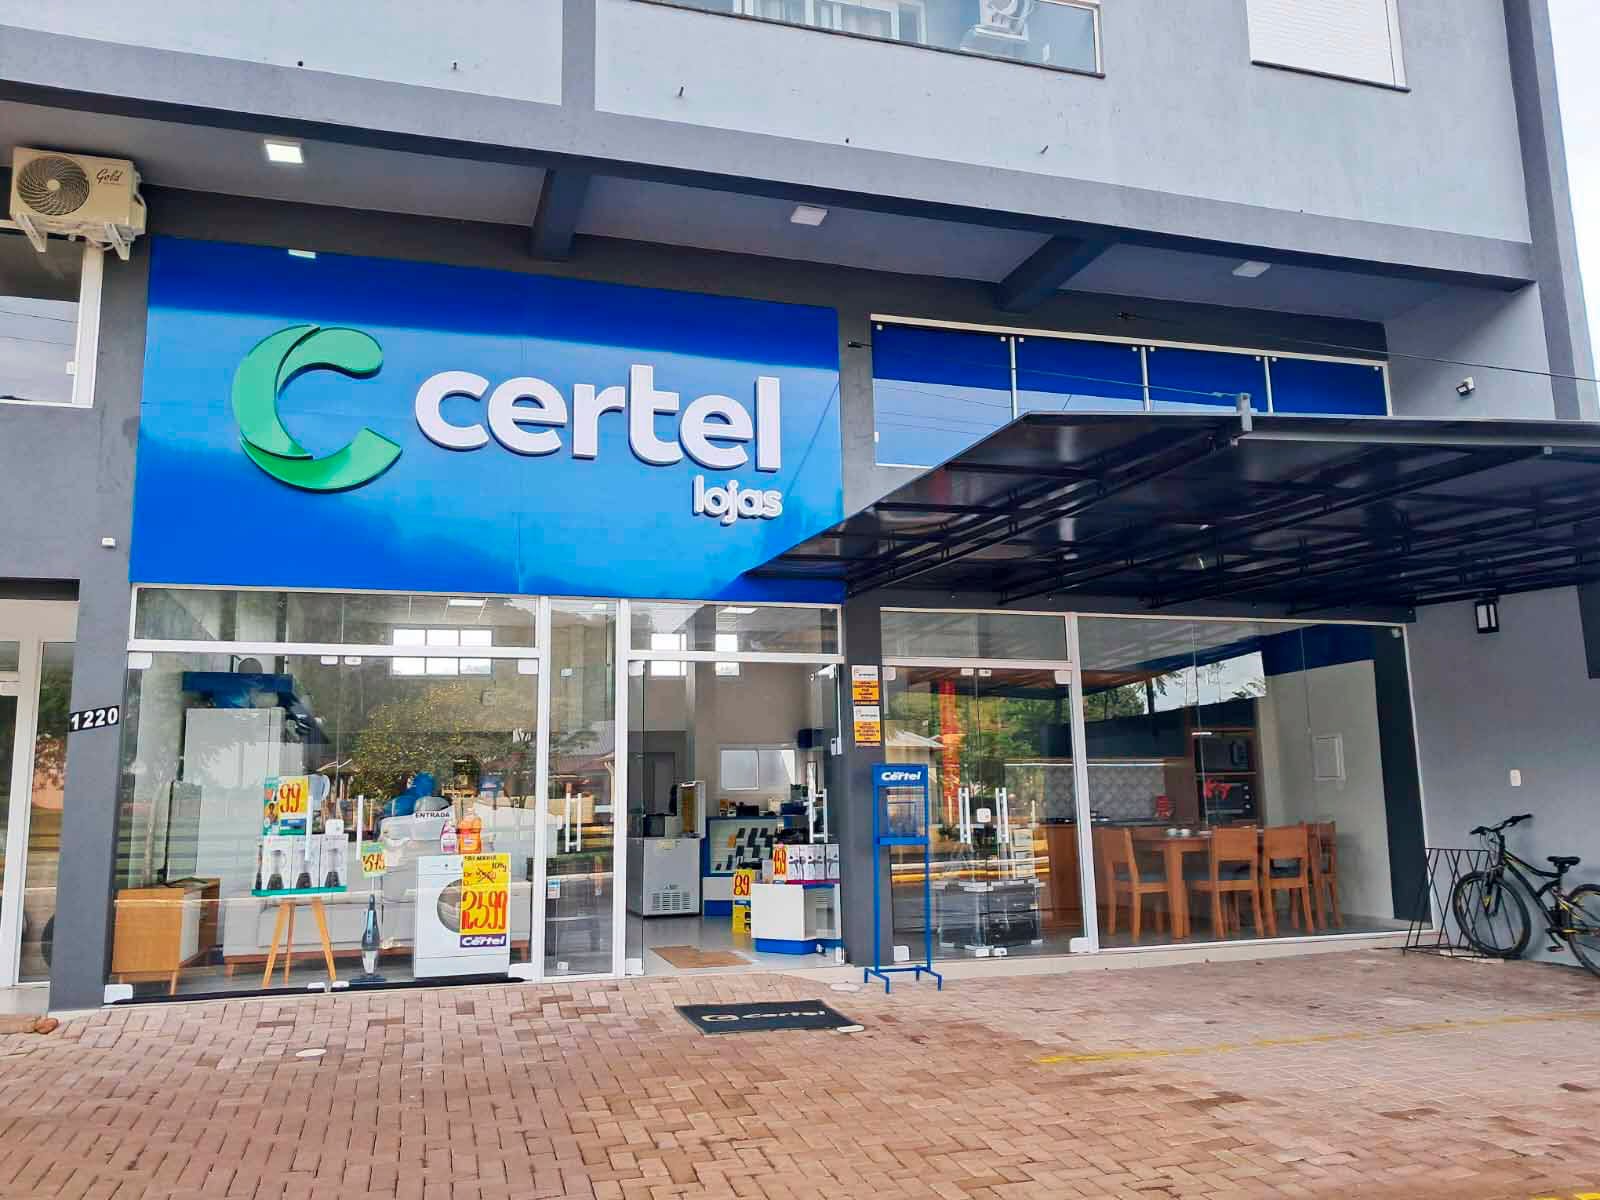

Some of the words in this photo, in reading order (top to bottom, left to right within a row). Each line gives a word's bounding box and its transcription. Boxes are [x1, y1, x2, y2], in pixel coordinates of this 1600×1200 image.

[97, 168, 123, 184] Gold
[416, 364, 781, 472] certel
[693, 475, 783, 526] lojas
[71, 707, 118, 730] 1220
[881, 771, 921, 781] Certel
[734, 874, 750, 896] 89
[462, 935, 506, 946] Certel
